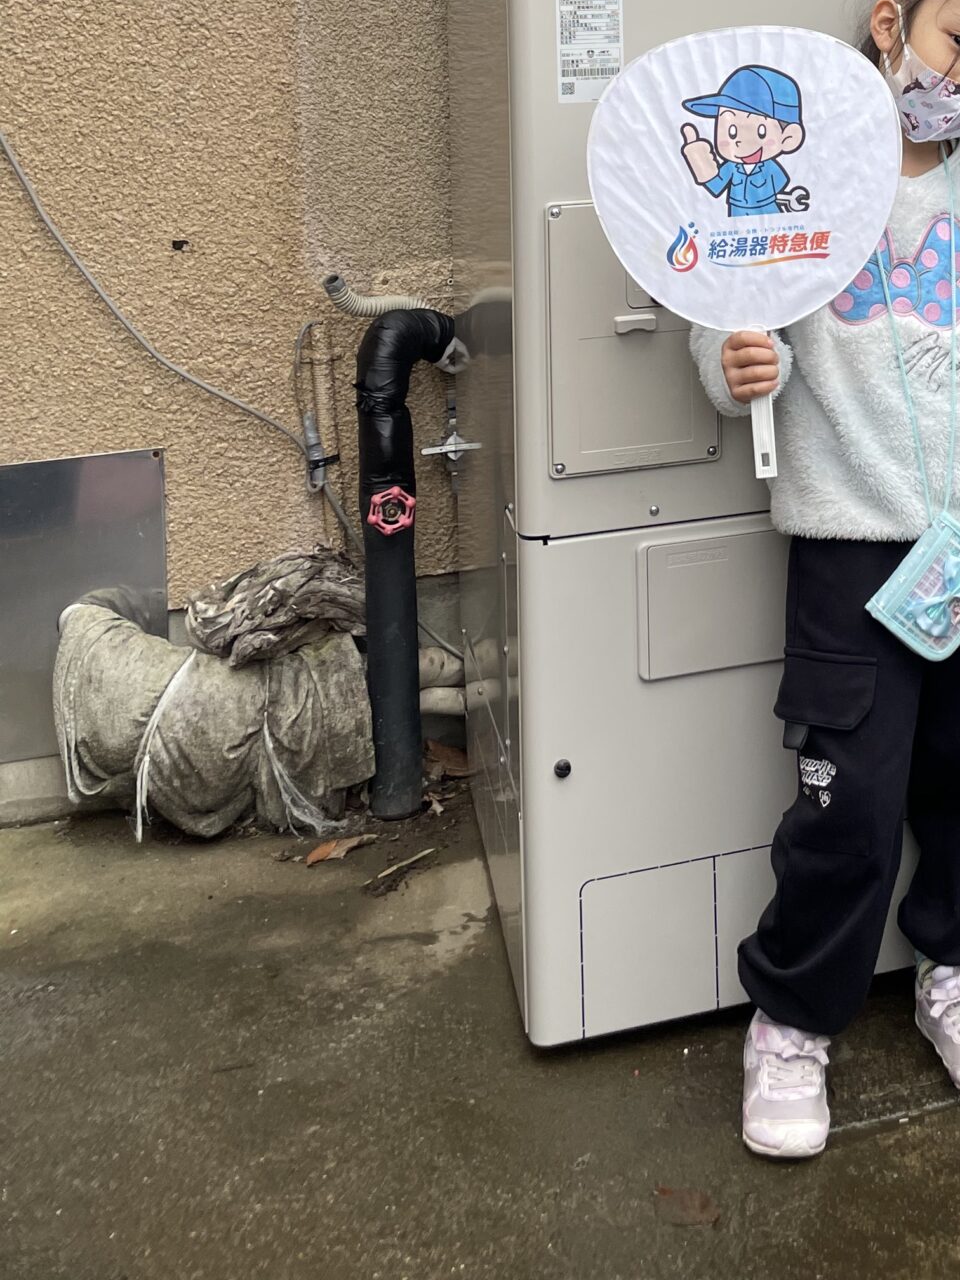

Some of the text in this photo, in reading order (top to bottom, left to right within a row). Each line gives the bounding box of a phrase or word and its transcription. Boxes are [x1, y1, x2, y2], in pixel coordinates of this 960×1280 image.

[707, 230, 832, 260] 給湯器特急便
